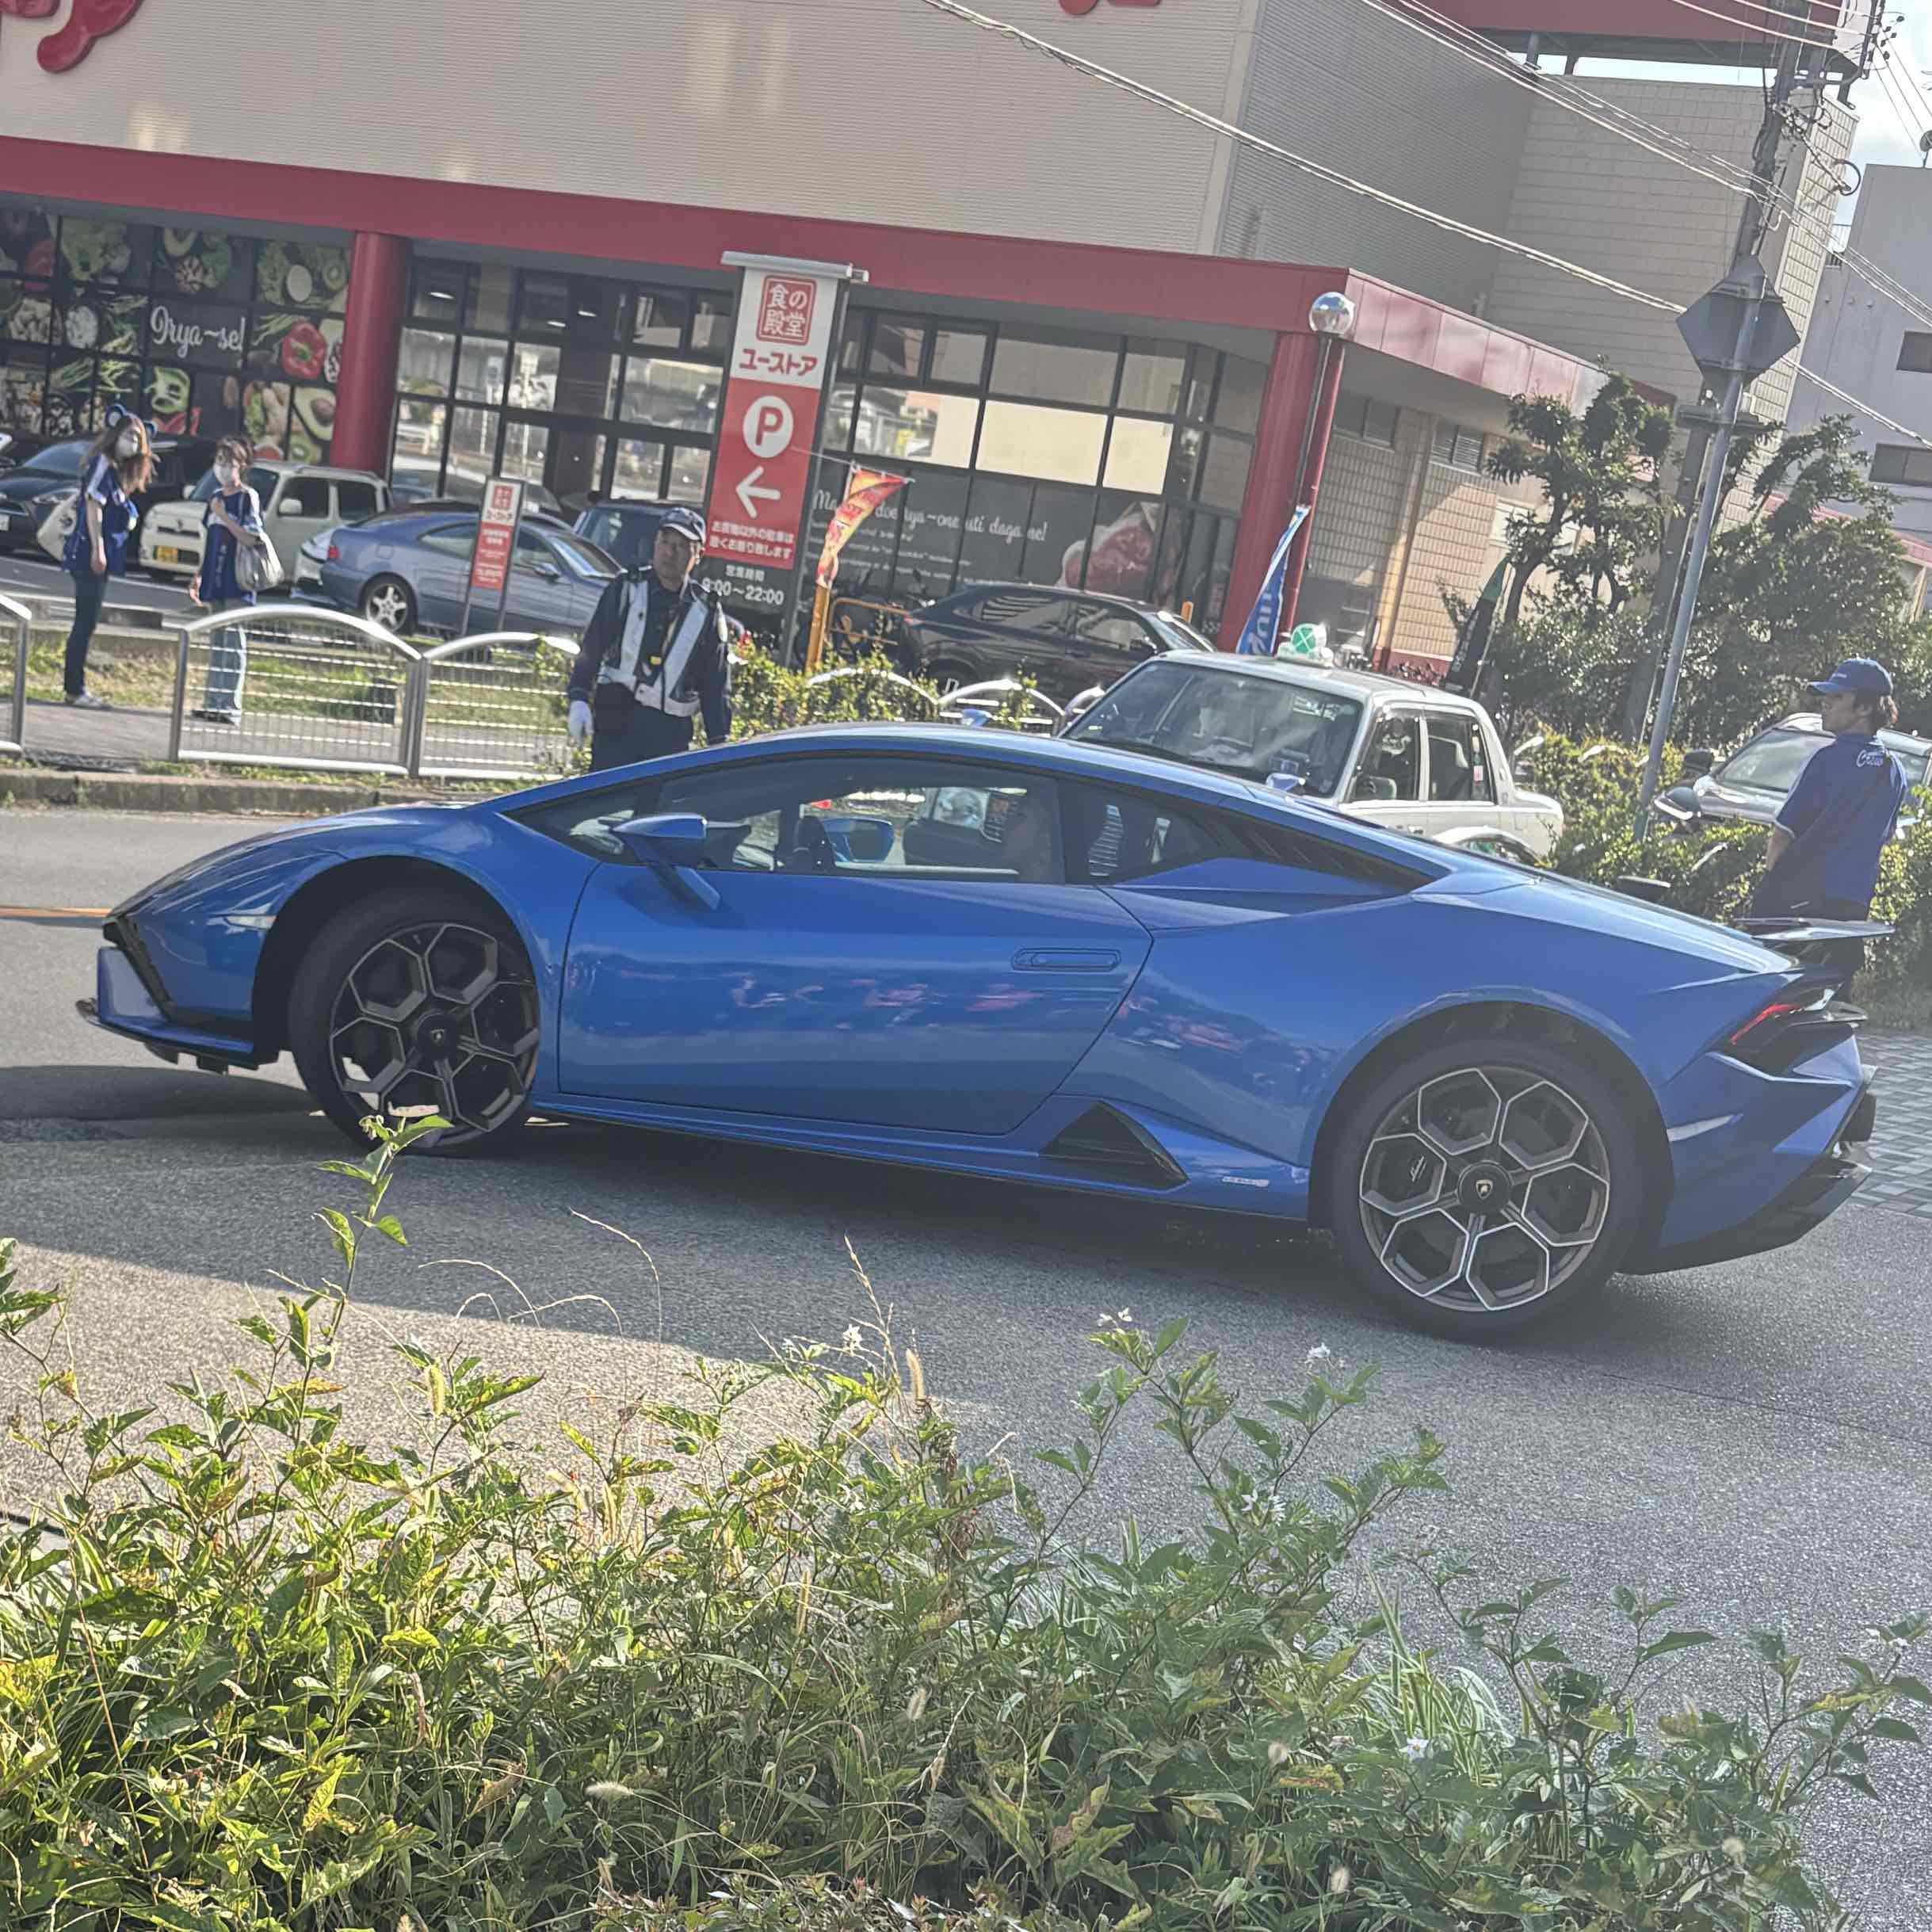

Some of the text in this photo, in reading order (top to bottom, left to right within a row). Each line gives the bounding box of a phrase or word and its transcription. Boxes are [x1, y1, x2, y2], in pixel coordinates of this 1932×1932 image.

[766, 283, 808, 310] 食の
[762, 308, 806, 337] 殿堂
[739, 348, 818, 376] ユーストア
[755, 406, 784, 446] P
